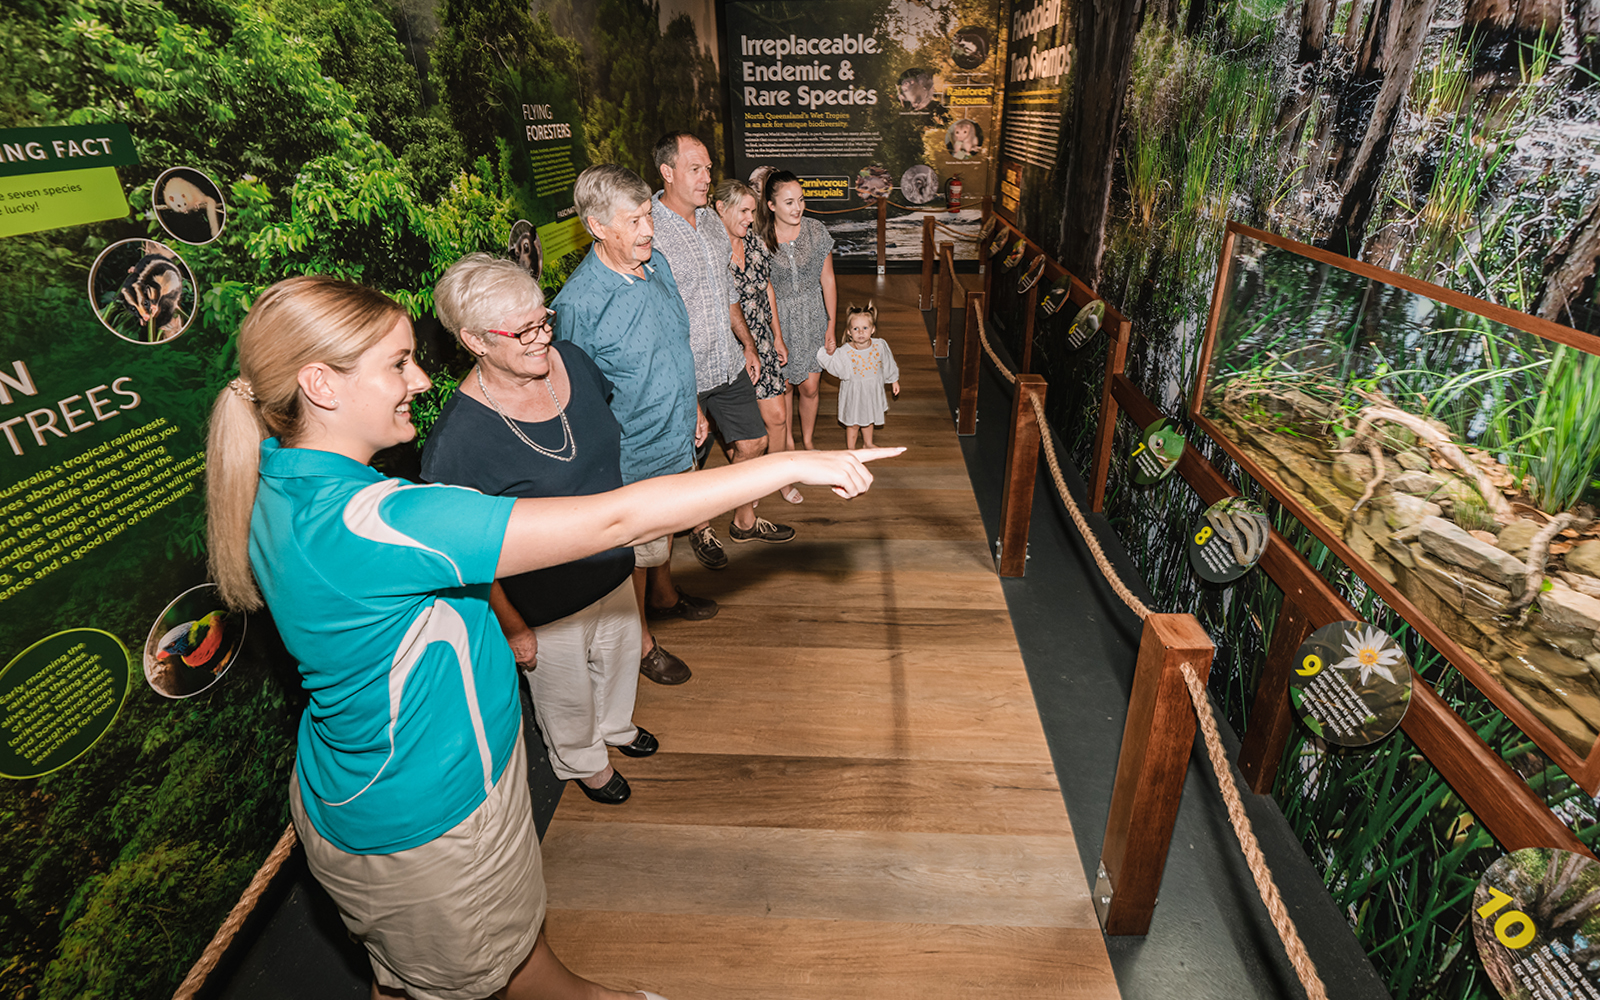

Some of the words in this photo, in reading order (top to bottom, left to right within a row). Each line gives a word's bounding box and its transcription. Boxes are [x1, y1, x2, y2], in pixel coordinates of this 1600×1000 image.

[740, 33, 883, 59] Irreplaceable,
[1010, 52, 1029, 83] Tree
[1028, 43, 1073, 85] Swamps
[742, 60, 832, 82] Endemic
[838, 60, 855, 81] &
[946, 86, 993, 96] Rainforest
[522, 103, 553, 121] FLYING
[744, 86, 791, 106] Rare
[797, 85, 878, 110] Species
[744, 112, 764, 120] North
[765, 112, 809, 120] Queensland's
[825, 112, 850, 120] Tropics
[950, 96, 988, 105] Possums
[52, 138, 113, 159] FACT
[526, 123, 572, 142] FORESTERS
[4, 201, 40, 215] lucky!
[7, 189, 41, 200] seven
[43, 183, 82, 197] species
[1068, 323, 1078, 335] 6
[0, 376, 141, 456] TREES
[25, 480, 66, 502] above
[66, 465, 95, 485] your
[95, 449, 128, 468] head.
[127, 434, 158, 453] While
[158, 425, 178, 440] you
[63, 441, 110, 468] tropical
[110, 417, 167, 447] rainforests
[1131, 442, 1146, 457] 7
[8, 511, 33, 526] the
[33, 487, 81, 514] wildlife
[82, 469, 121, 490] above,
[121, 445, 166, 471] spotting
[17, 523, 42, 538] the
[42, 502, 82, 526] forest
[81, 487, 111, 506] floor
[111, 464, 156, 490] through
[155, 455, 172, 467] the
[46, 515, 87, 540] tangle
[87, 504, 101, 518] of
[101, 480, 151, 510] branches
[152, 467, 172, 483] and
[171, 455, 197, 472] vines
[196, 451, 205, 460] is
[12, 561, 34, 573] To
[34, 542, 62, 563] find
[61, 533, 82, 547] life
[82, 525, 97, 536] in
[96, 513, 117, 527] the
[117, 497, 145, 516] trees
[145, 486, 166, 503] you
[165, 474, 184, 489] will
[184, 461, 206, 479] need
[34, 559, 61, 579] and
[61, 555, 71, 564] a
[71, 534, 103, 560] good
[104, 522, 126, 540] pair
[127, 512, 140, 525] of
[139, 482, 194, 518] binoculars!
[1193, 525, 1214, 546] 8
[6, 675, 56, 711] rainforest
[55, 652, 88, 676] comes
[25, 654, 69, 685] morning
[67, 643, 85, 655] the
[1295, 654, 1322, 676] 9
[1, 708, 26, 728] alive
[26, 691, 50, 708] with
[49, 678, 67, 691] the
[67, 654, 101, 679] sounds
[11, 720, 24, 732] of
[23, 702, 50, 723] birds
[50, 679, 83, 704] calling
[82, 664, 100, 679] and
[54, 669, 111, 711] honeyeaters
[15, 736, 35, 755] and
[34, 696, 89, 739] bowerbirds
[88, 677, 114, 697] move
[24, 726, 65, 759] through
[64, 713, 81, 727] the
[81, 687, 114, 714] canopy
[31, 727, 78, 766] searching
[78, 715, 92, 728] for
[1476, 885, 1536, 949] 10
[1512, 963, 1525, 977] for
[1522, 976, 1535, 991] the
[1521, 958, 1538, 975] and
[1540, 945, 1554, 960] the
[1550, 959, 1578, 989] animal
[1550, 938, 1571, 964] When
[1568, 962, 1582, 978] the
